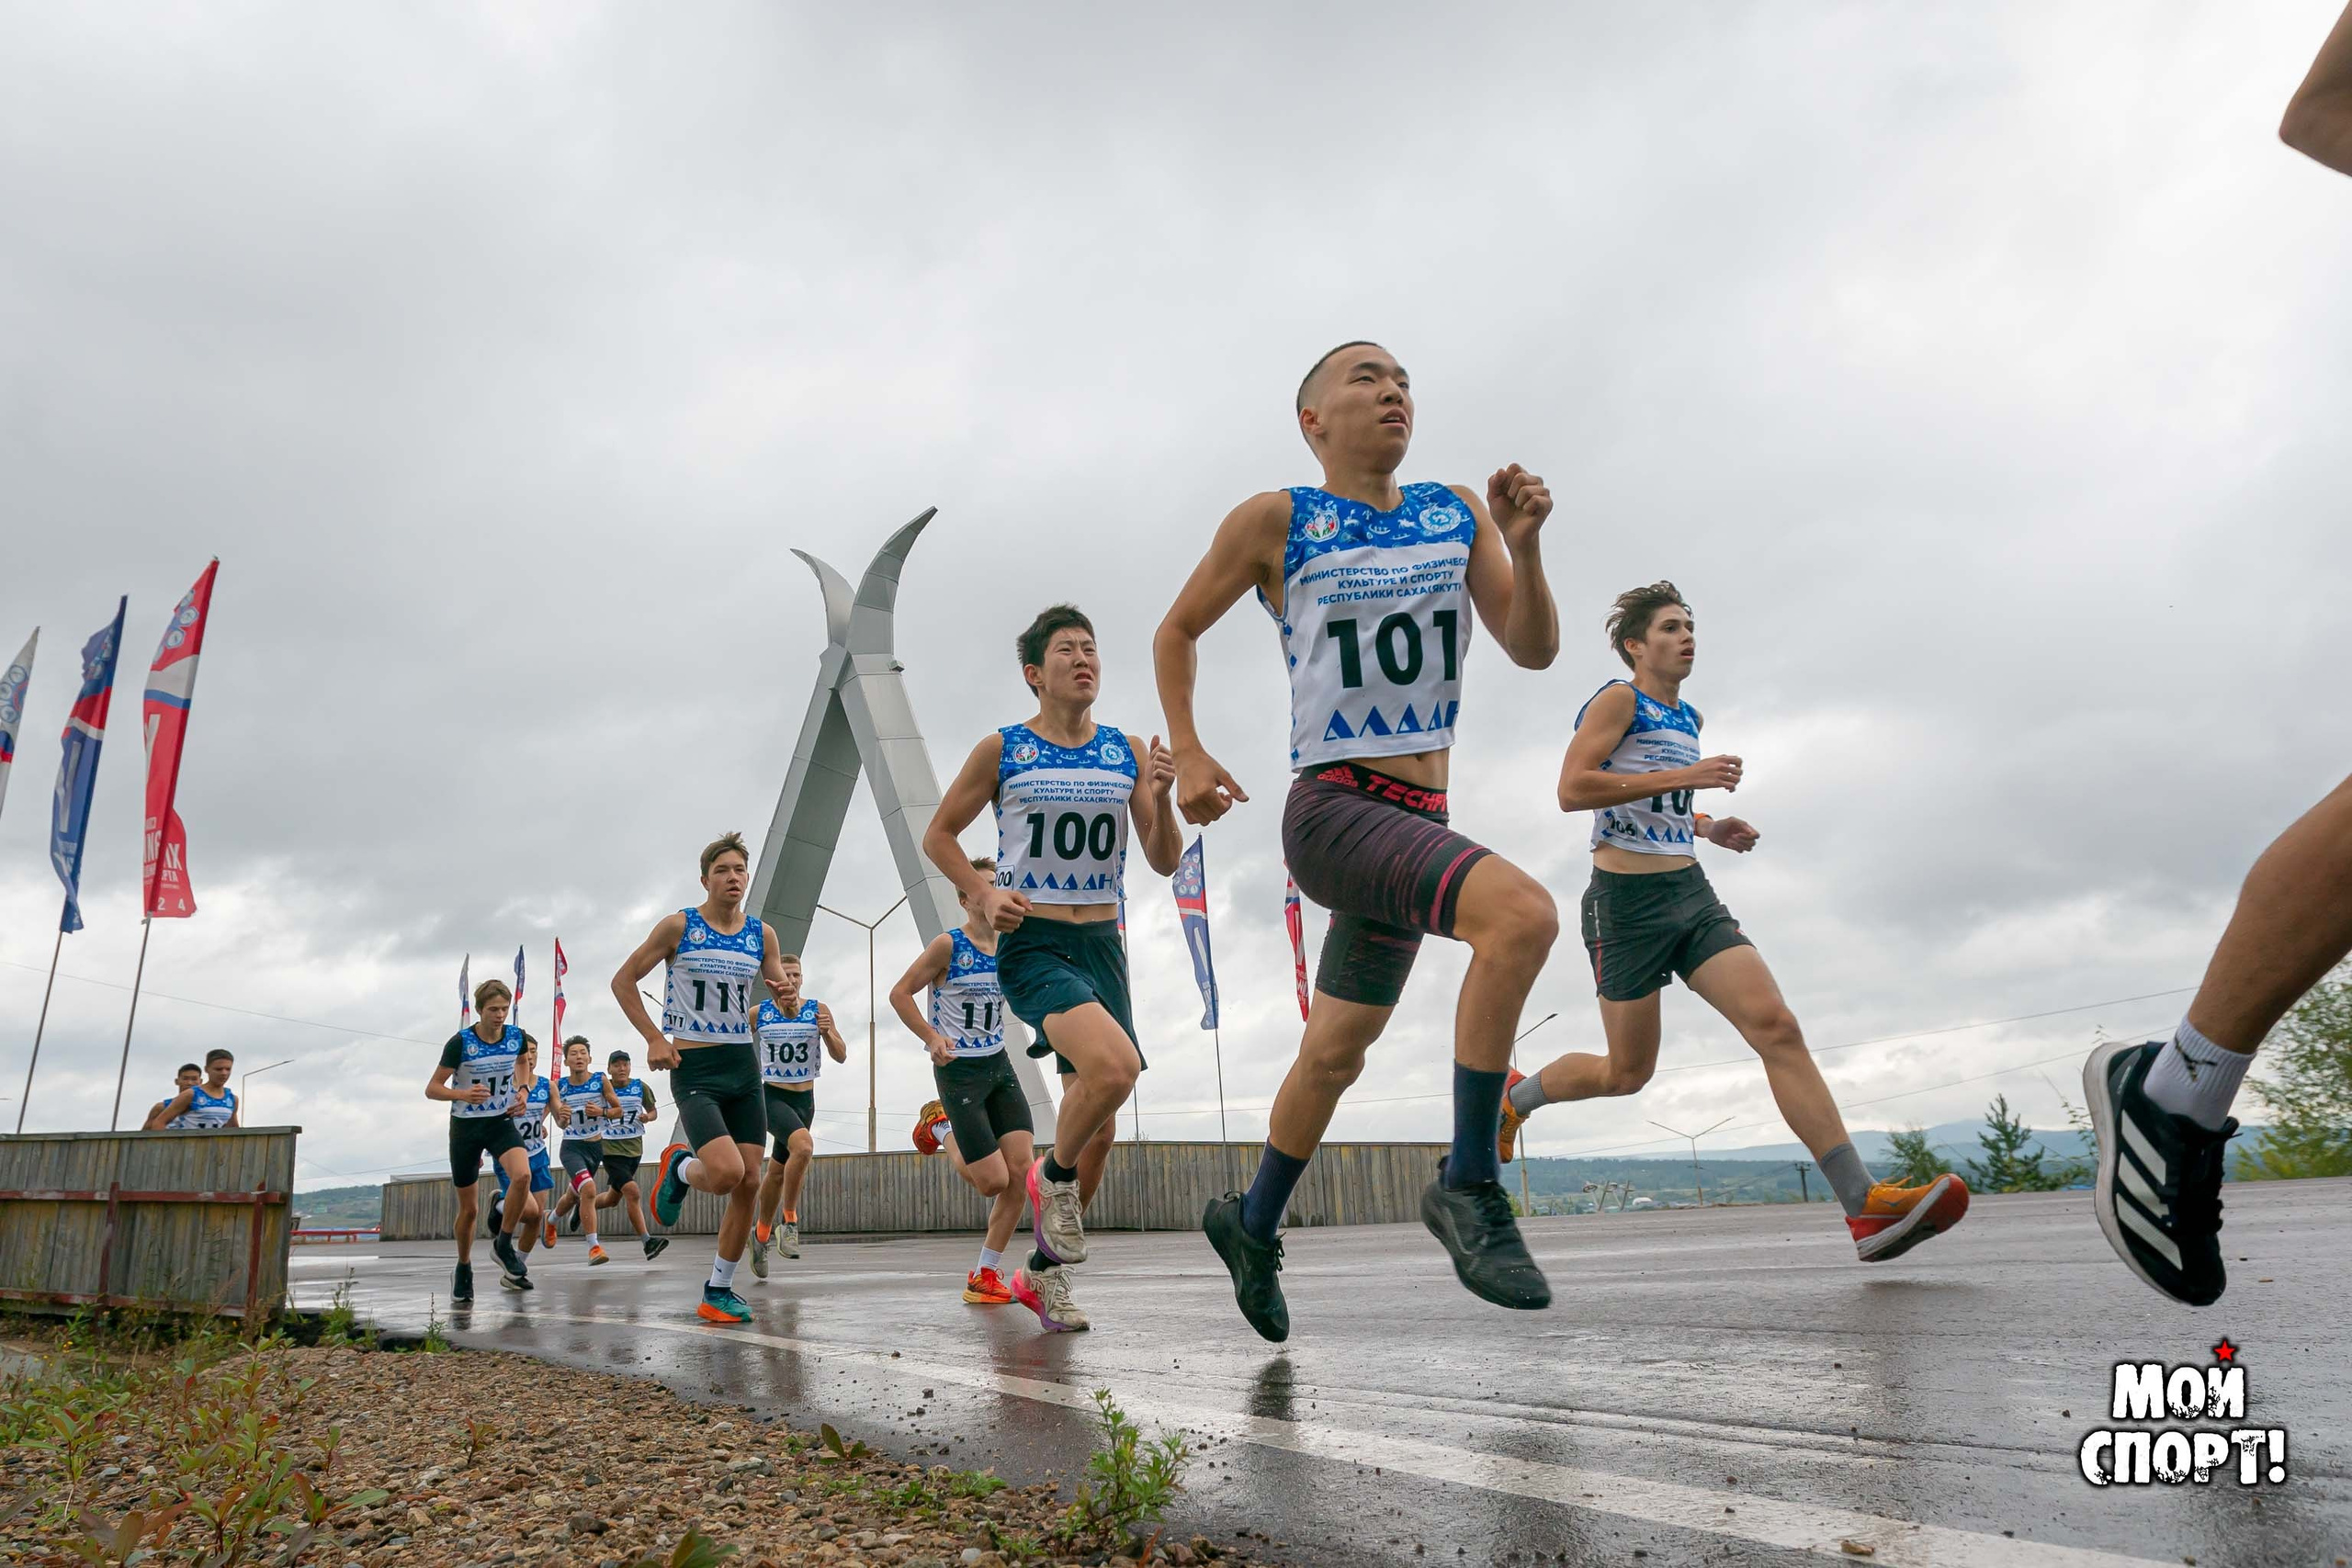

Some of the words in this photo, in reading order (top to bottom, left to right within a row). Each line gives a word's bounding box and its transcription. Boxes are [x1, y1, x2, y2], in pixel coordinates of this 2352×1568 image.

[1300, 567, 1388, 586] МИНИСТЕРСТВО
[1338, 578, 1396, 589] КУЛЬТУРЕ
[1400, 577, 1408, 585] И
[1410, 571, 1454, 584] СПОРТУ
[1317, 590, 1394, 606] РЕСПУБЛИКИ
[1327, 609, 1458, 689] 101
[1009, 780, 1071, 790] МИНИСТЕРСТВО
[1317, 773, 1359, 788] adidas
[1019, 795, 1071, 804] РЕСПУБЛИКИ
[1026, 812, 1116, 862] 100
[996, 871, 1012, 886] 00
[1019, 871, 1114, 890] АЛДАН
[693, 979, 745, 1014] 111
[668, 1014, 684, 1028] 111
[768, 1042, 808, 1064] 103
[472, 1072, 514, 1096] 15
